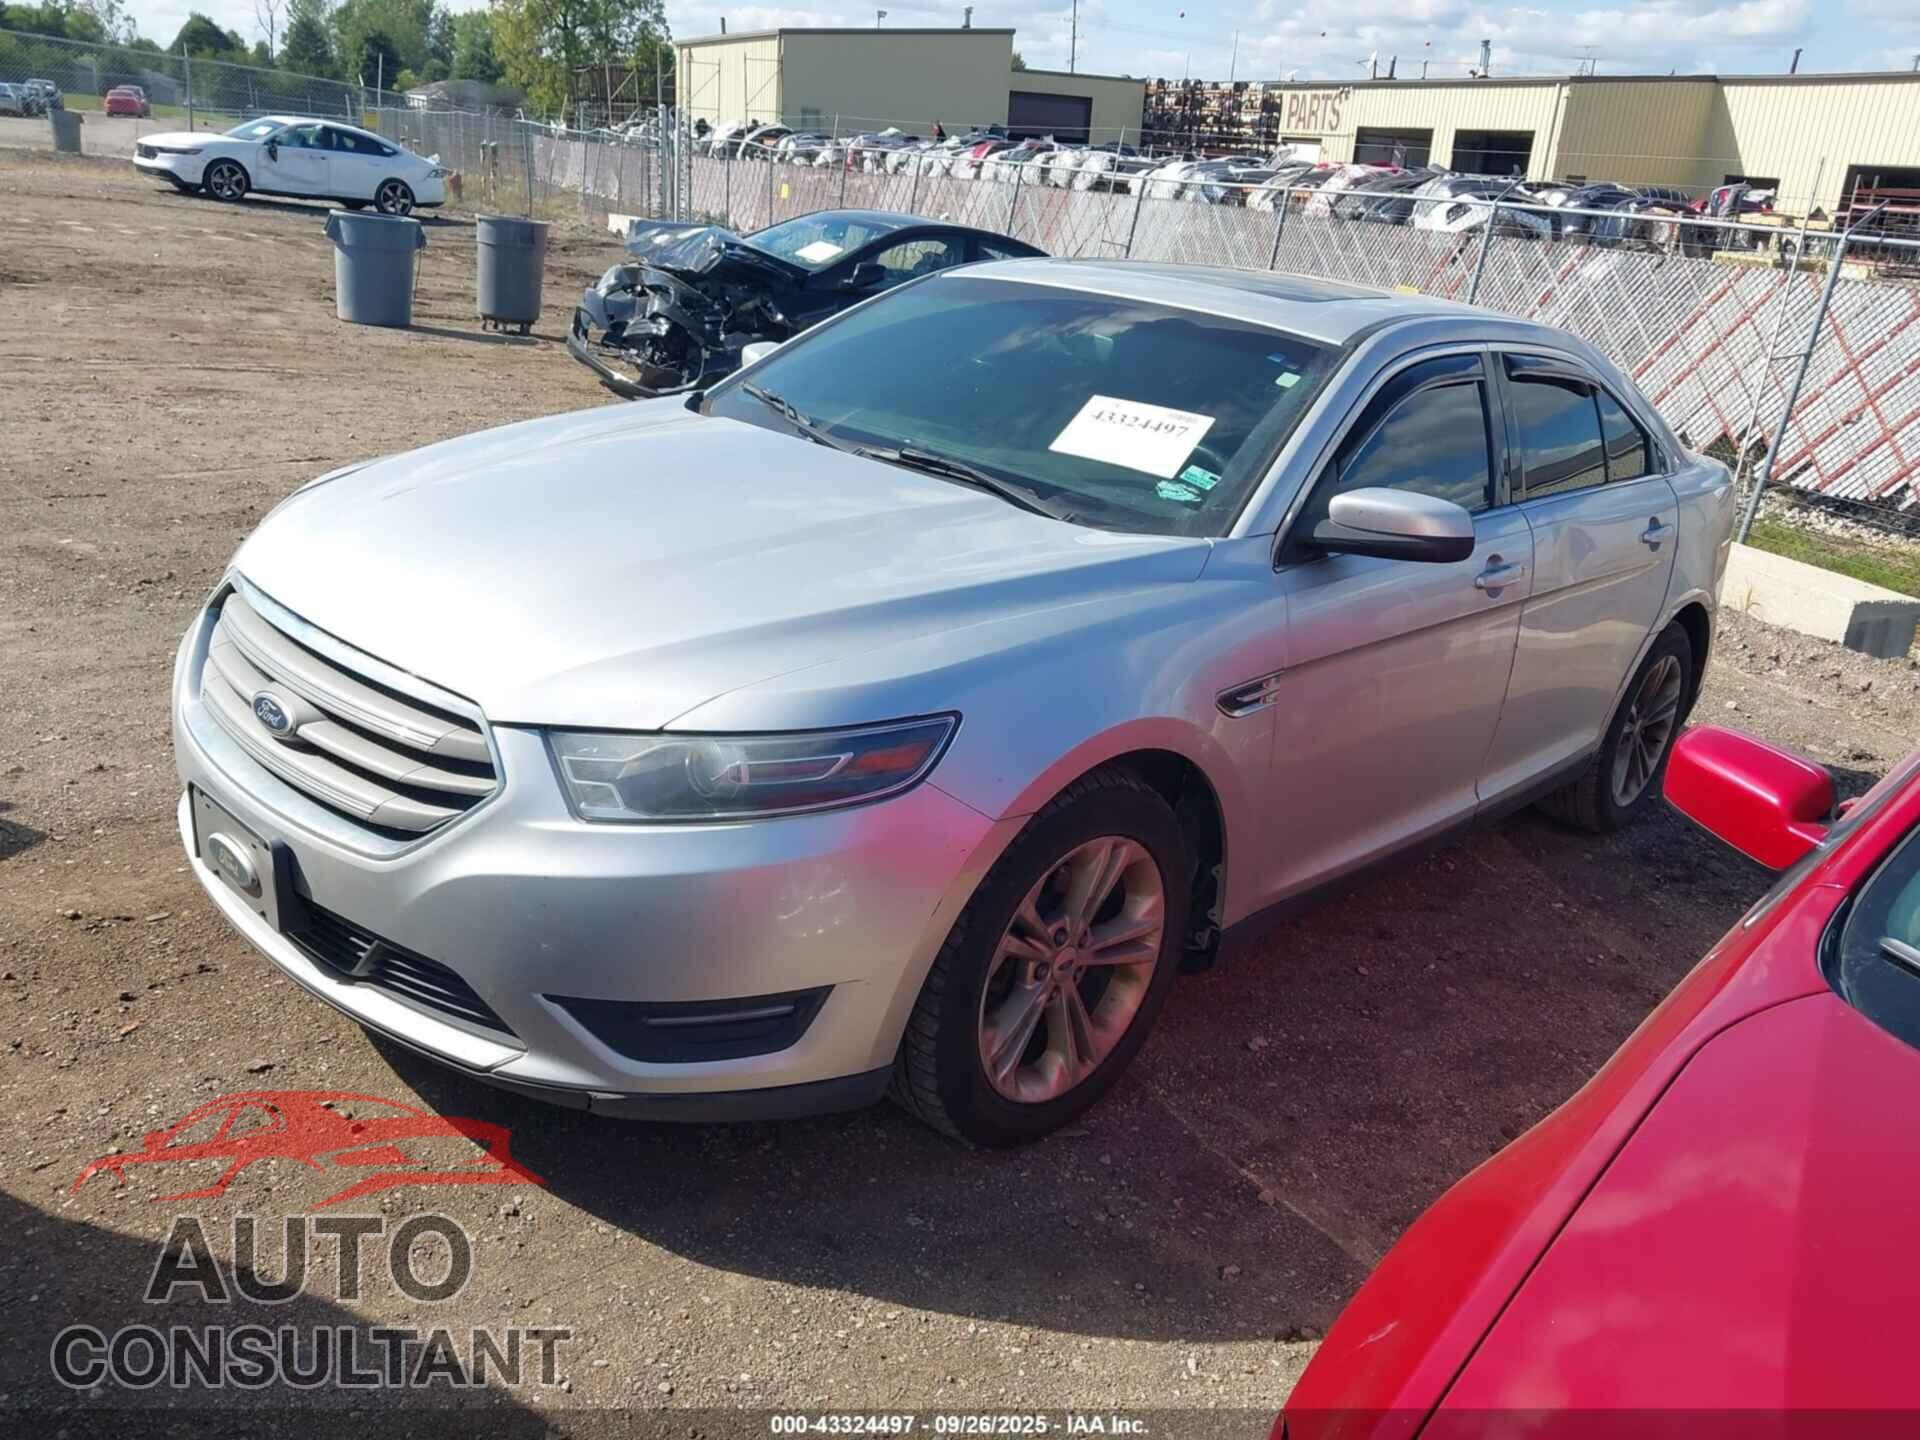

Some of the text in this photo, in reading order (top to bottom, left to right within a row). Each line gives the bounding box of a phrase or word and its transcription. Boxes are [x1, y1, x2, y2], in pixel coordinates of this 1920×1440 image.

[1287, 93, 1342, 131] PARTS
[1091, 409, 1189, 438] 43324497
[256, 700, 283, 727] Ford
